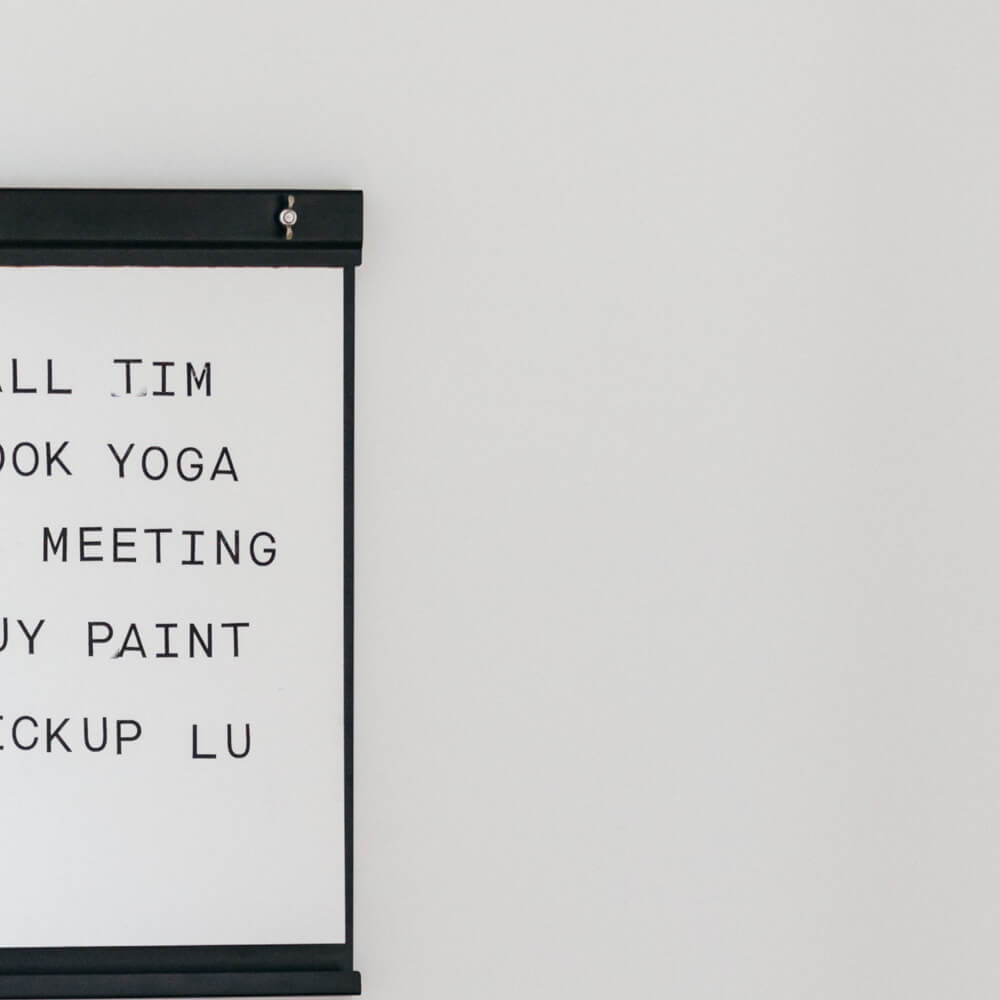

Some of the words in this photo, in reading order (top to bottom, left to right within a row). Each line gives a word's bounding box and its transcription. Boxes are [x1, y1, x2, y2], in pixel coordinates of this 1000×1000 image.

[112, 359, 213, 397] TIM
[107, 443, 239, 482] YOGA
[42, 526, 278, 567] MEETING
[87, 621, 250, 659] PAINT
[191, 723, 252, 760] LU
